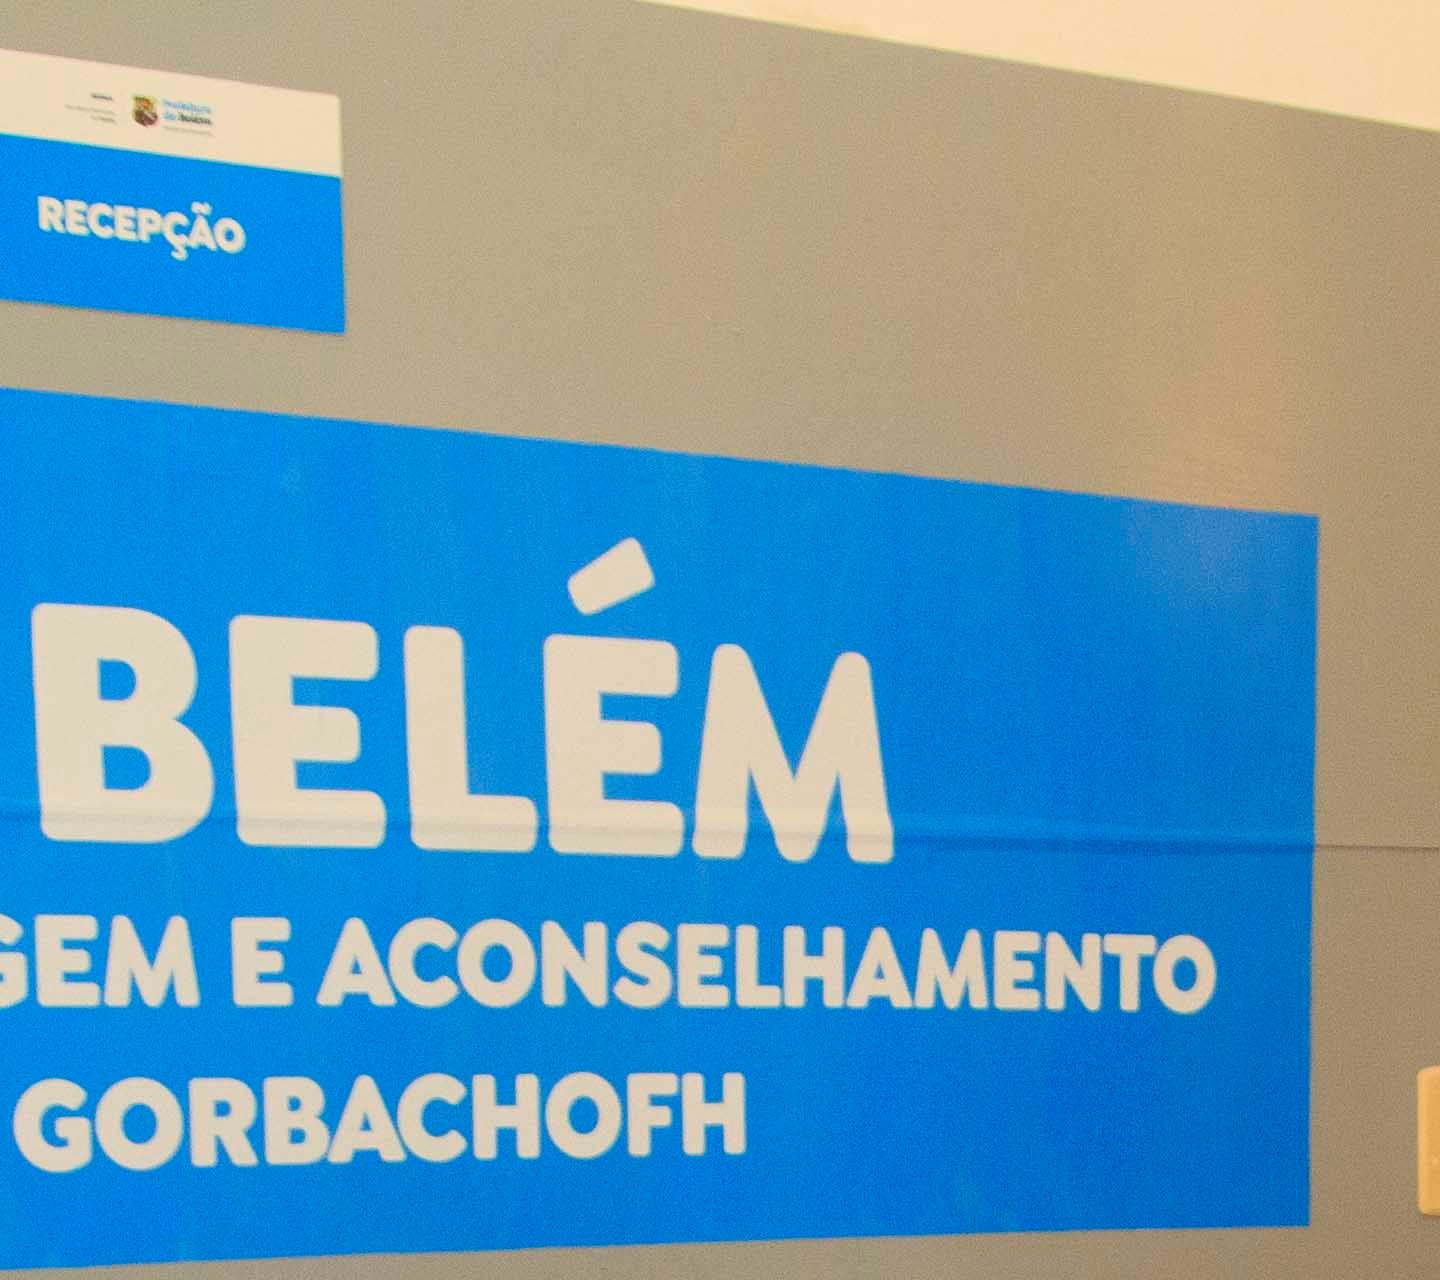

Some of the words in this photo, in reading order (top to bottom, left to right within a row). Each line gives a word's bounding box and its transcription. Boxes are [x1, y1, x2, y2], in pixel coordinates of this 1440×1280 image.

[37, 196, 247, 260] RECEPÇÃO
[31, 538, 895, 864] BELÉM
[231, 917, 293, 1008] E
[316, 917, 1217, 1015] ACONSELHAMENTO
[13, 1071, 747, 1174] GORBACHOFH
